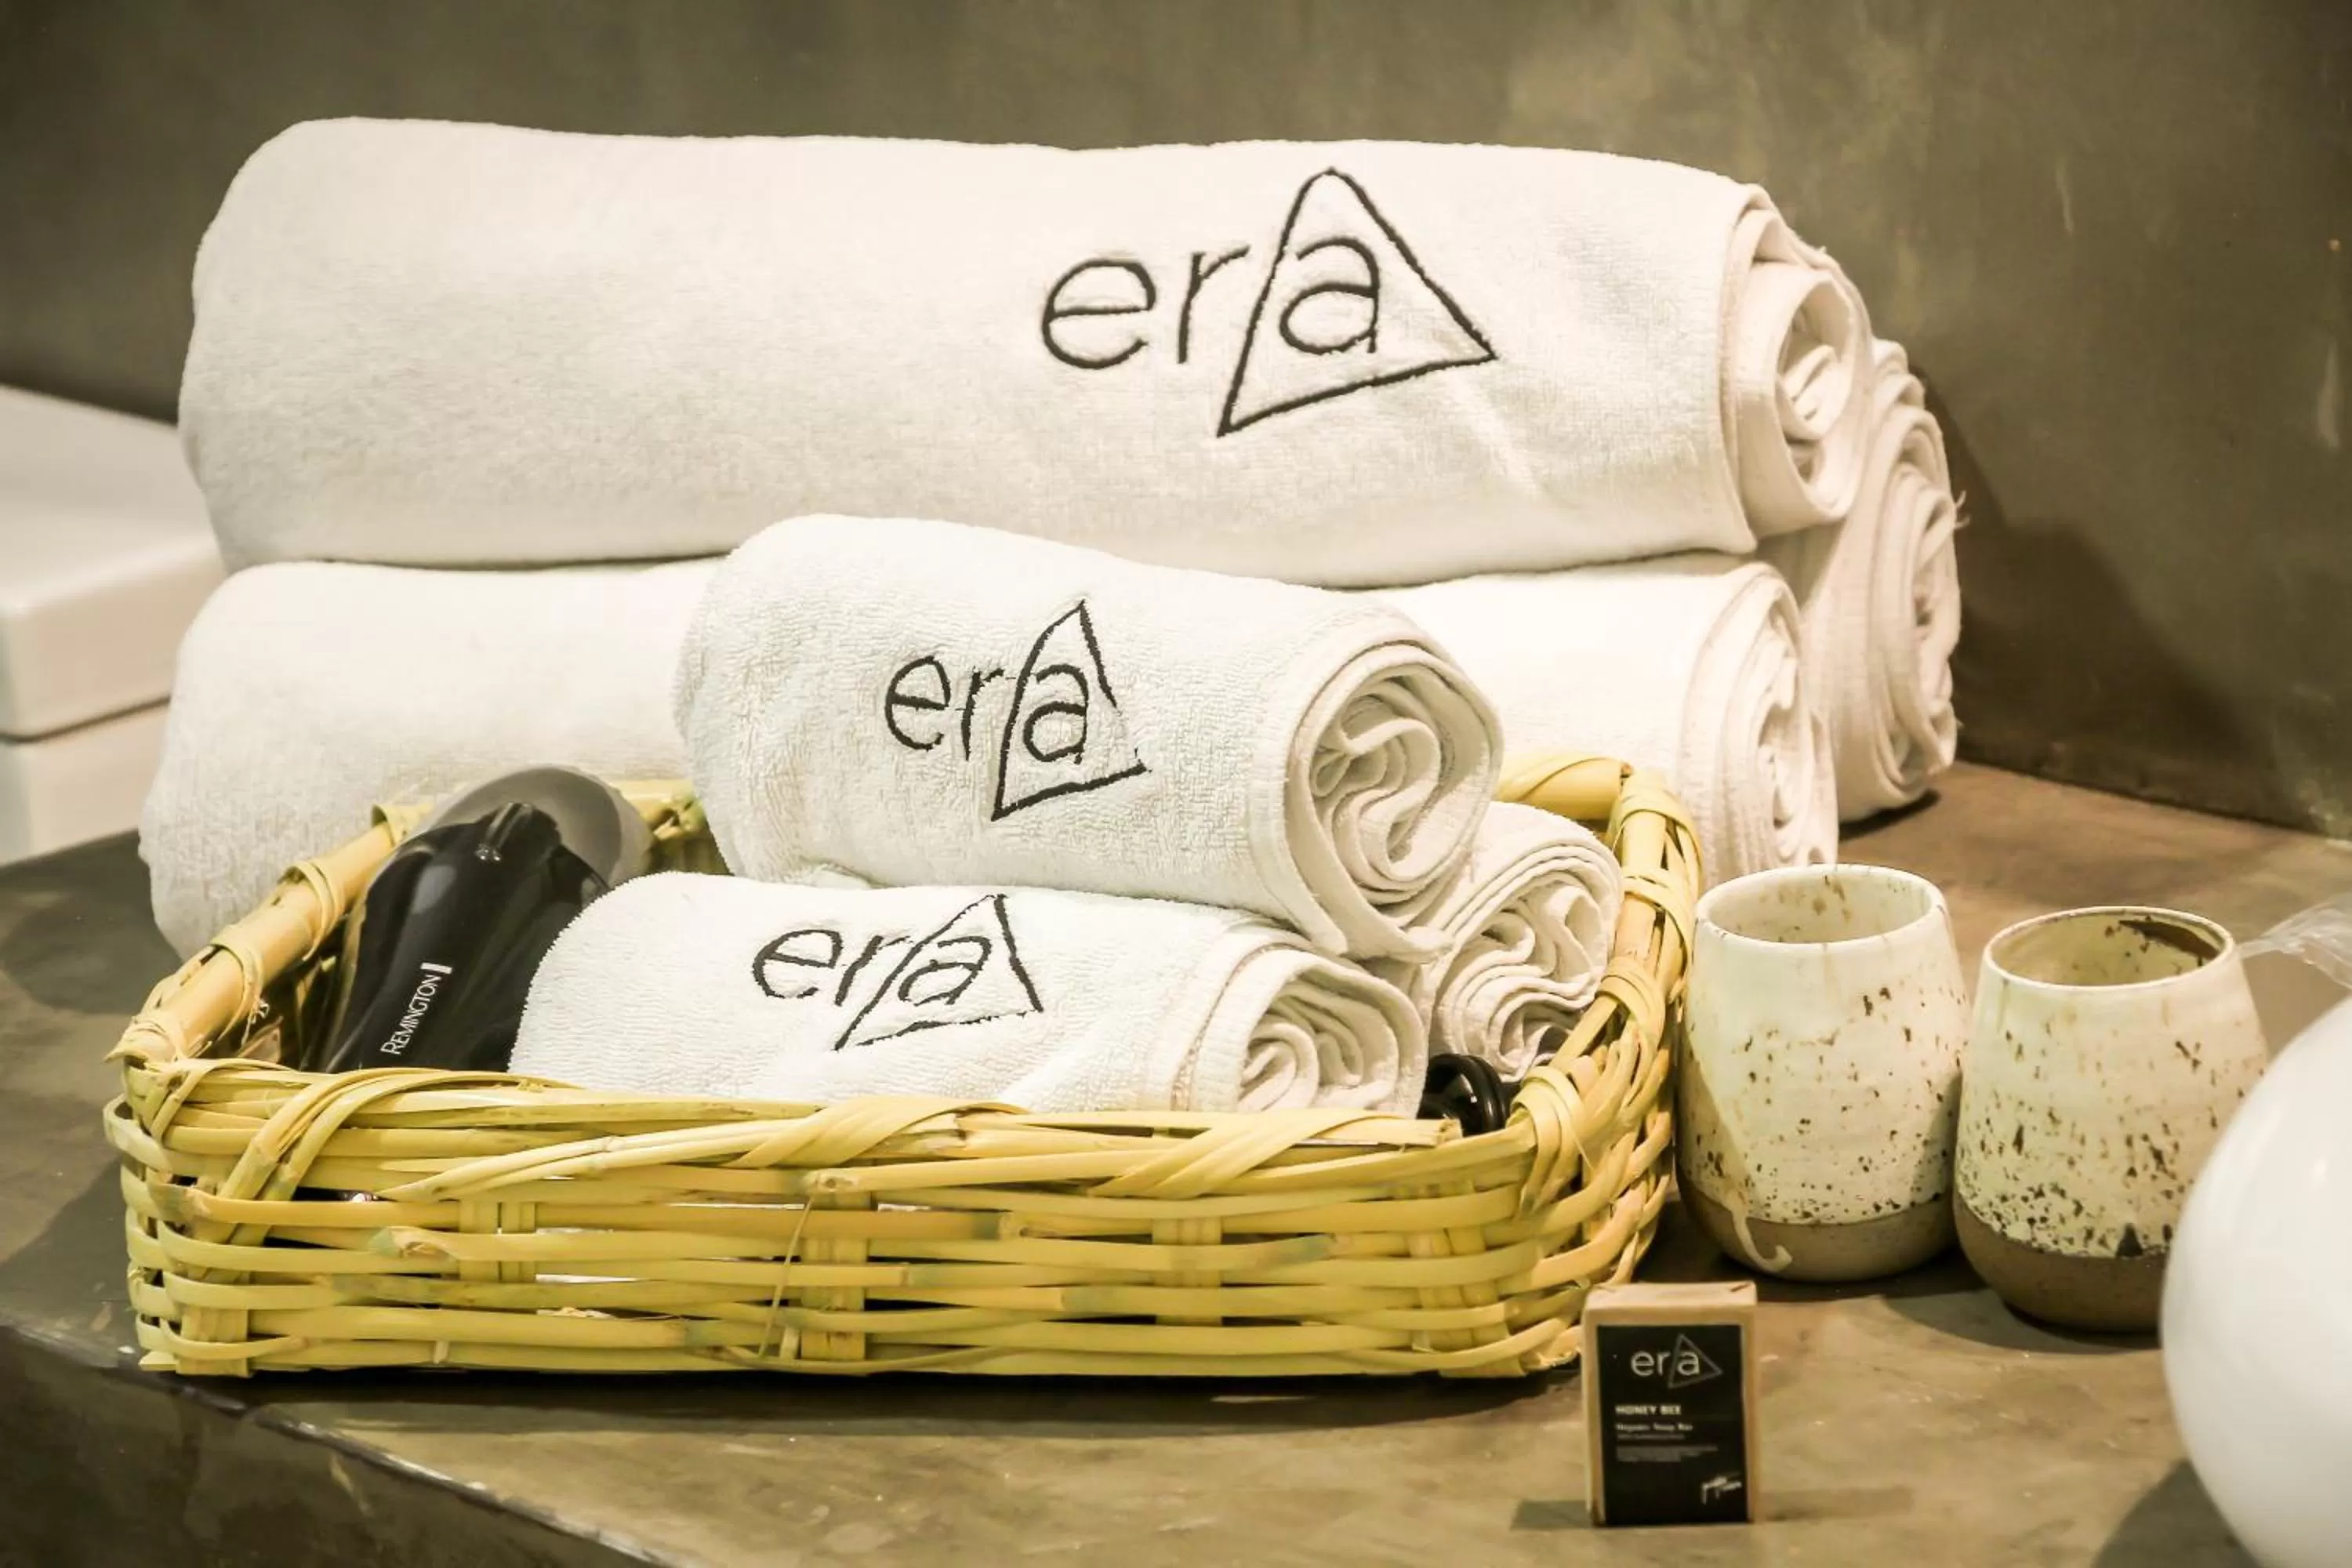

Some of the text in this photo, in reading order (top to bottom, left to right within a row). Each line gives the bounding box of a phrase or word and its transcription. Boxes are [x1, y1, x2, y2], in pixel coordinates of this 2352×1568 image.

[1041, 237, 1380, 370] era
[884, 655, 1089, 764] era
[751, 927, 992, 1007] era
[380, 974, 442, 1055] REMINGTON
[1631, 1351, 1700, 1377] era
